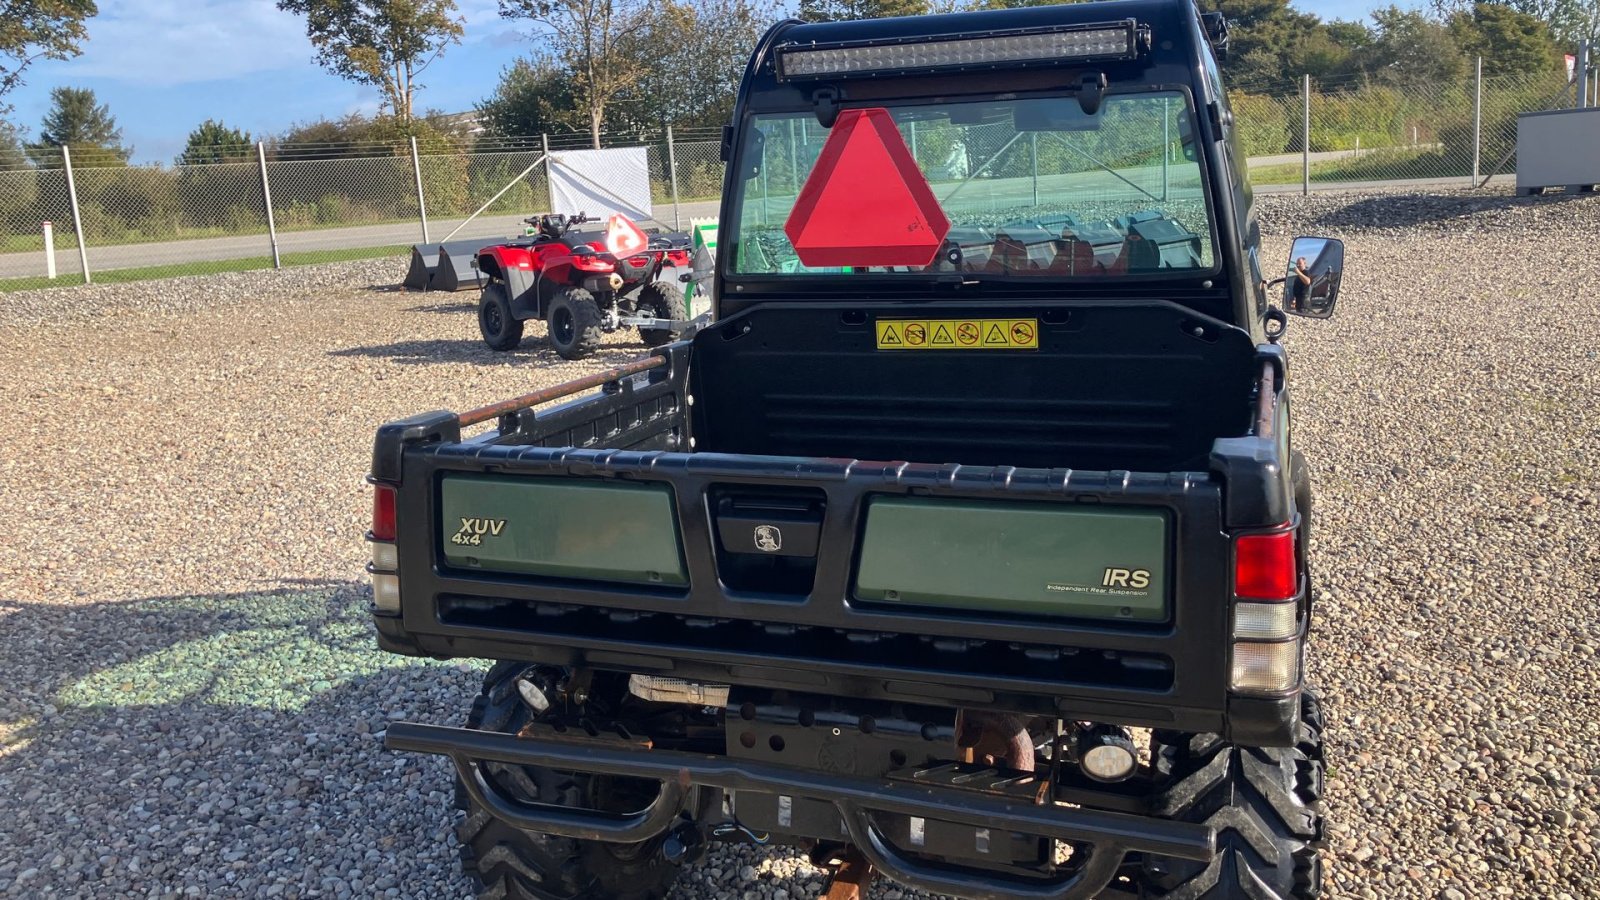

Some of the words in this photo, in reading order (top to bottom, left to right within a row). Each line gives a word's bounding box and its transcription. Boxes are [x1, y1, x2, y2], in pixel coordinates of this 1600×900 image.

[459, 517, 505, 535] XUV
[451, 532, 481, 546] 4x4
[1102, 568, 1150, 589] IRS
[1046, 584, 1089, 592] Independent
[1108, 588, 1148, 596] Suspension
